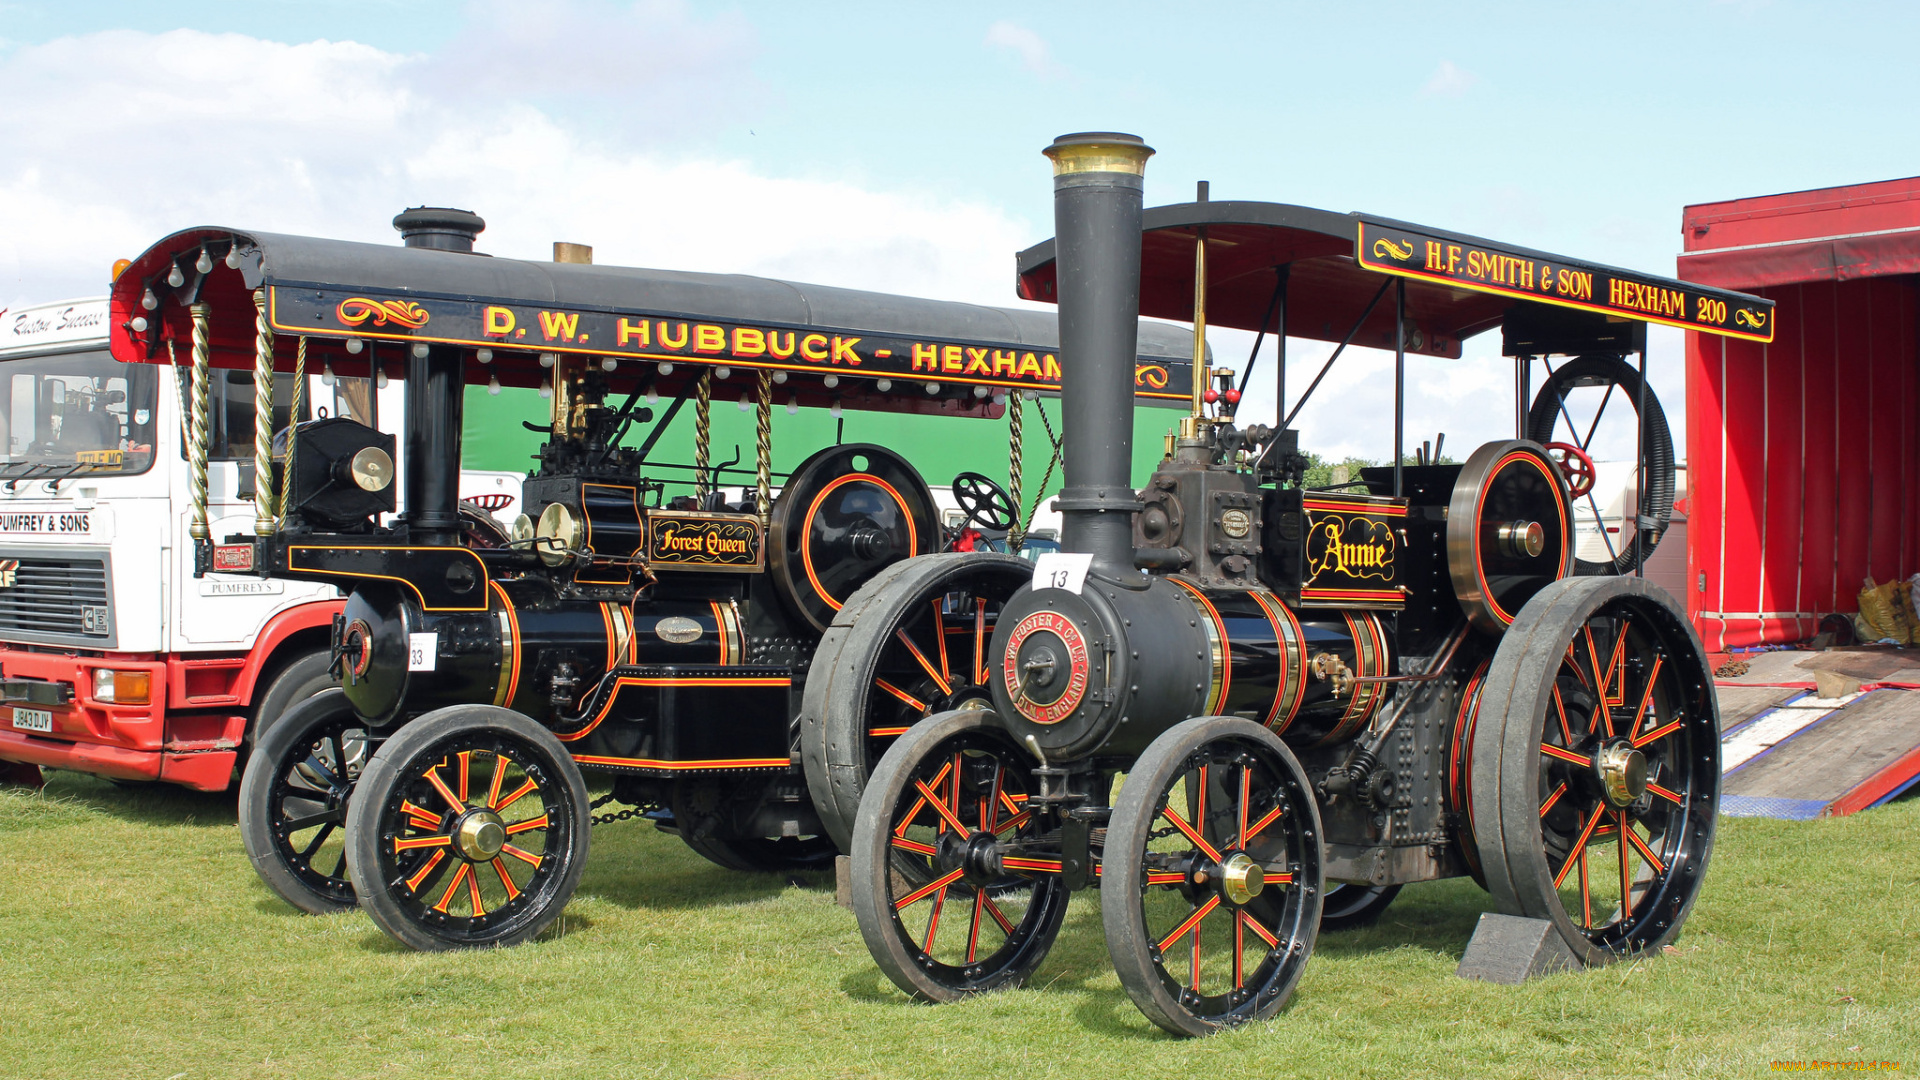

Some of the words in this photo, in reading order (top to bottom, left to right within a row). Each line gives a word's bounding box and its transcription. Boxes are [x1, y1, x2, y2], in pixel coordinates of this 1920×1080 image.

[1424, 240, 1463, 274] H.F.
[1467, 250, 1535, 290] SMITH
[1540, 265, 1554, 291] &
[1557, 268, 1593, 300] SON
[1608, 278, 1686, 319] HEXHAM
[1697, 296, 1727, 325] 200
[483, 305, 526, 339] D.
[537, 310, 590, 344] W.
[616, 317, 862, 366] HUBBUCK
[48, 515, 56, 531] &
[60, 514, 90, 532] SONS
[660, 529, 704, 551] Forest
[706, 531, 747, 555] Queen
[1316, 522, 1390, 576] Annie
[211, 582, 272, 593] PUMFREY'S
[1050, 570, 1069, 588] 13
[1014, 614, 1053, 642] FOSTER
[1055, 620, 1063, 631] &
[411, 649, 423, 665] 33
[1006, 668, 1040, 720] LINOLN.
